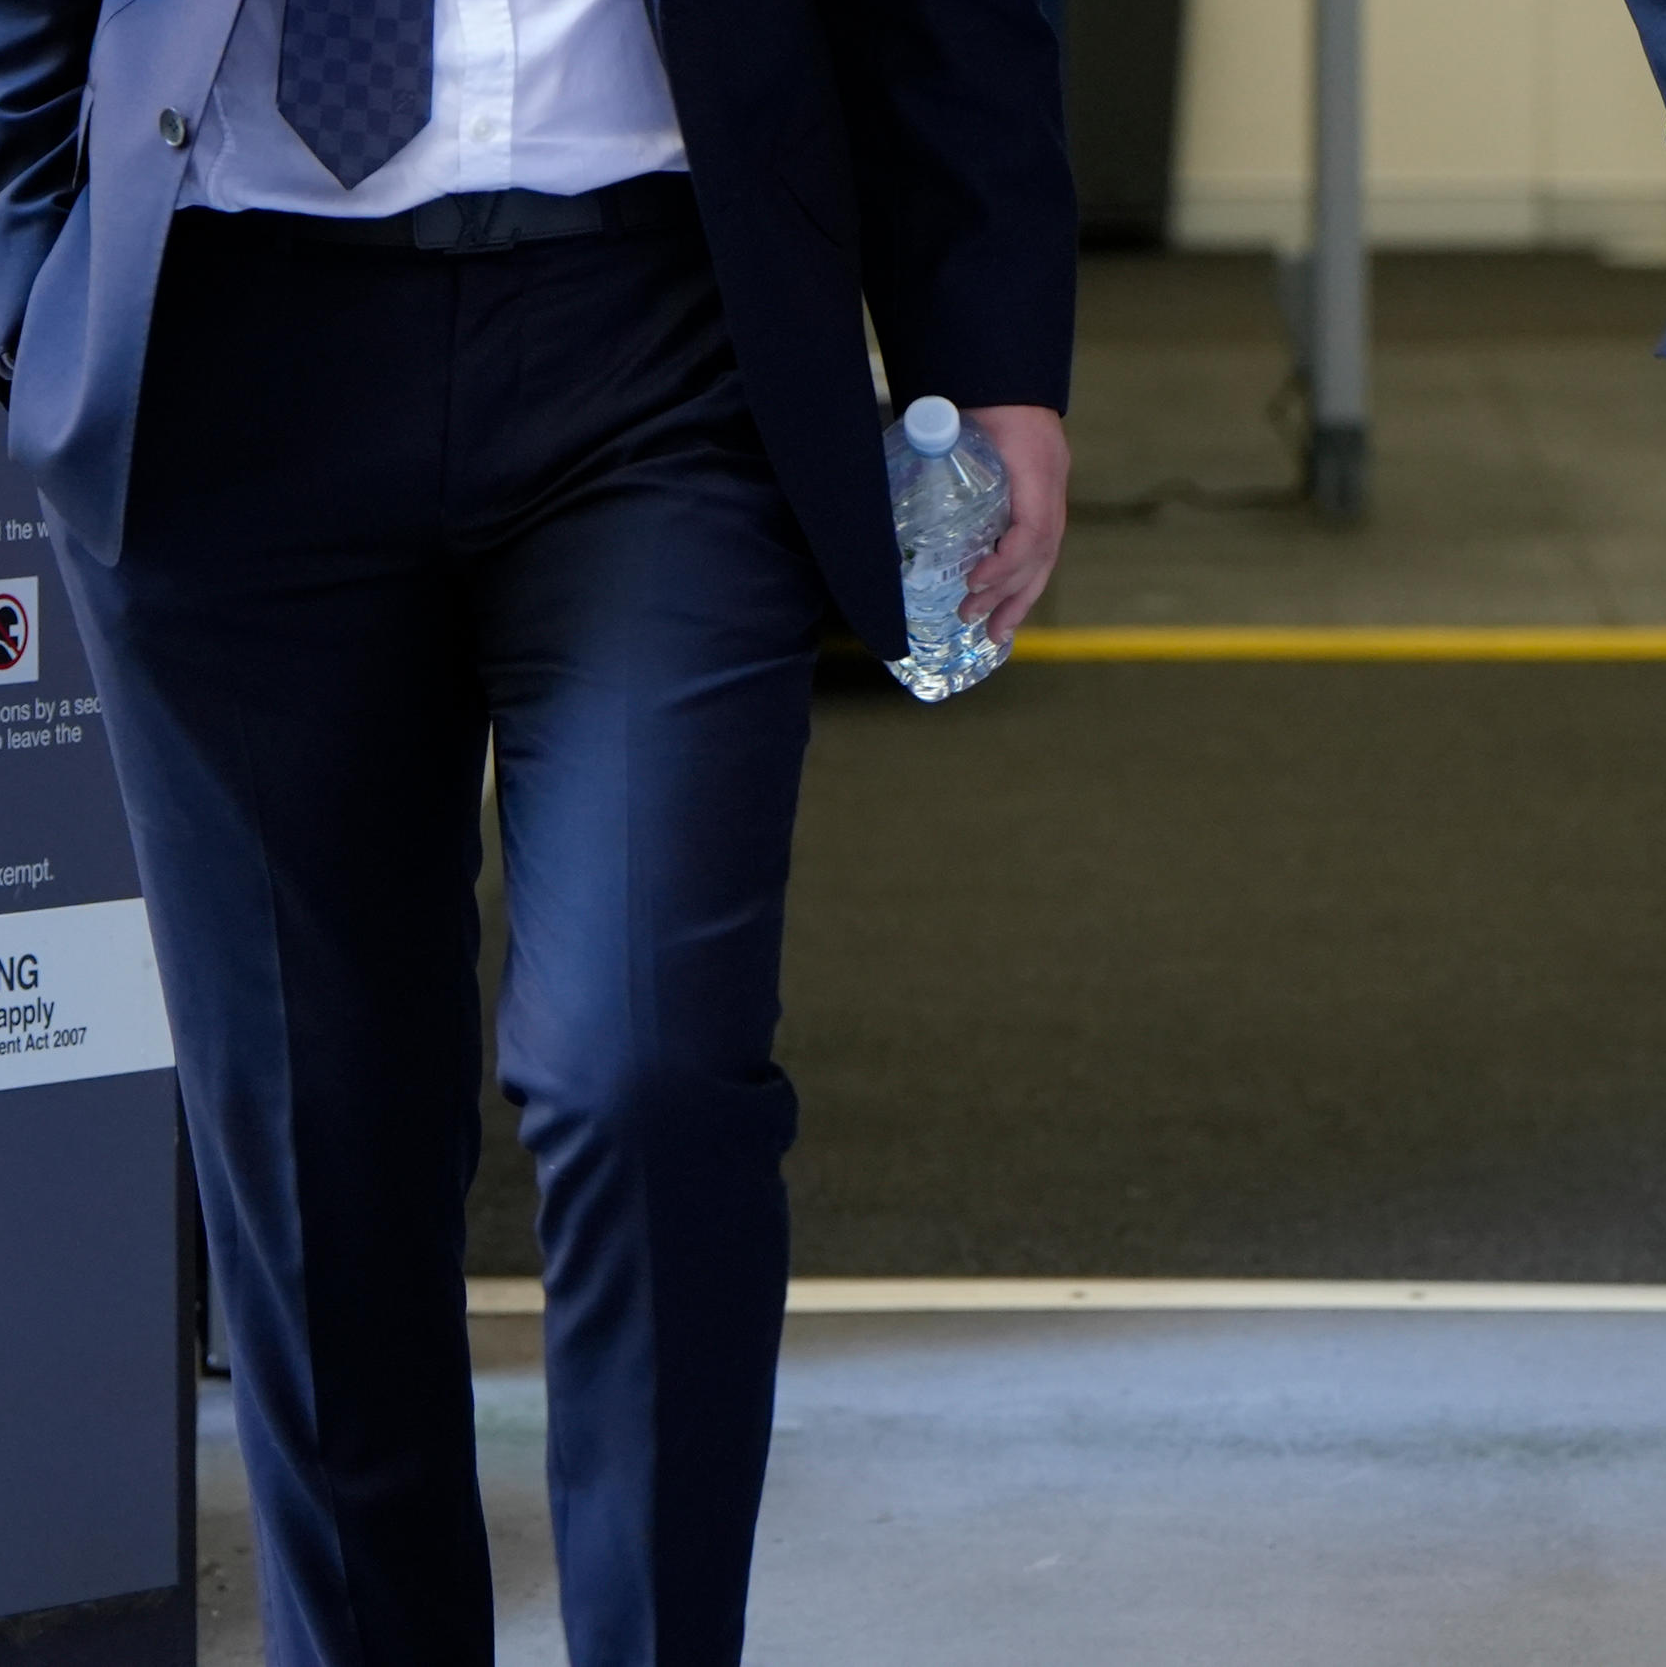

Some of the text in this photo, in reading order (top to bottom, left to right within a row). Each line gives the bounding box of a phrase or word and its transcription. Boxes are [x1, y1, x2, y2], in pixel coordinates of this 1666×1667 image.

[6, 518, 32, 539] the
[35, 697, 55, 722] by
[60, 701, 71, 716] a
[7, 725, 51, 750] leave
[55, 721, 83, 743] the
[25, 1032, 49, 1052] Act
[53, 1026, 87, 1050] 2007
